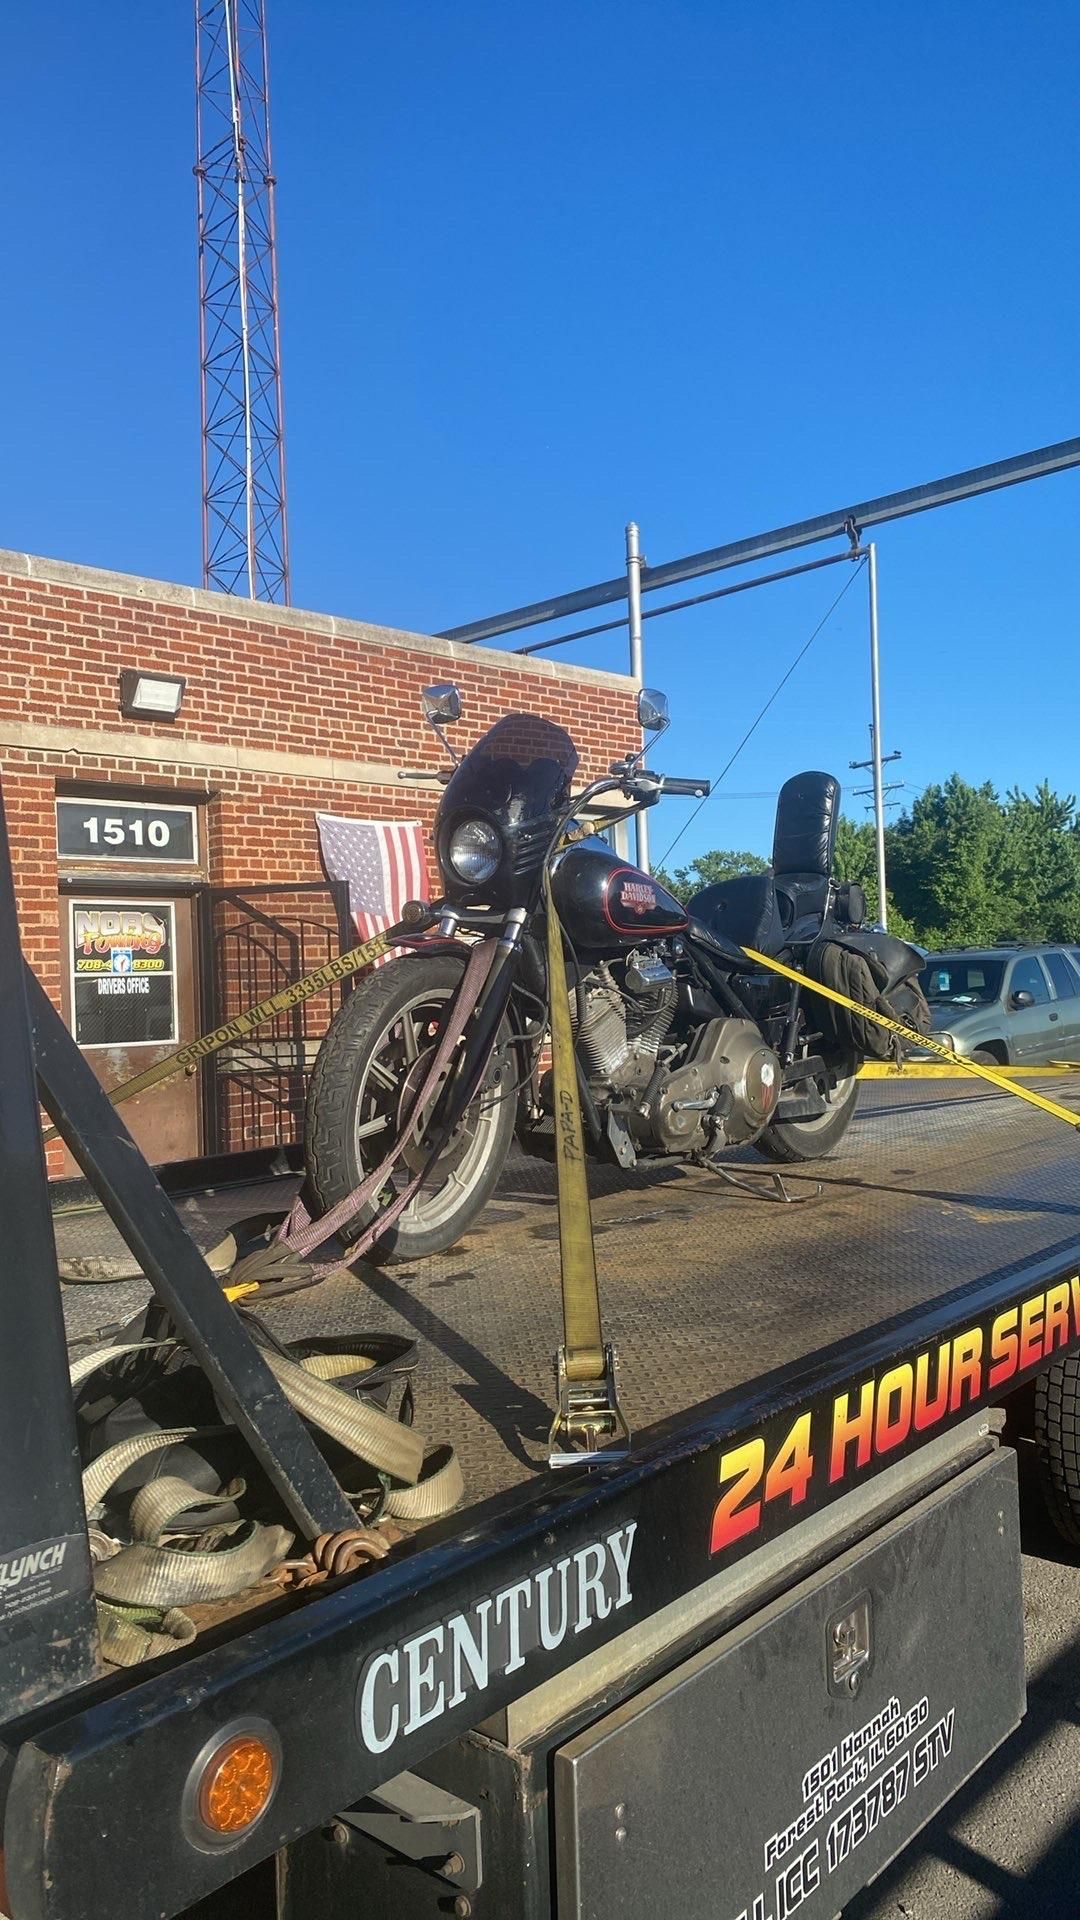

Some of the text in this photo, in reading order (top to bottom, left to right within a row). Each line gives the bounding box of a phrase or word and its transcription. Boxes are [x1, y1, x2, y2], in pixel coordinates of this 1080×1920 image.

[82, 816, 171, 848] 1510
[620, 890, 657, 905] DAVIDSON
[623, 881, 653, 892] HARLEY
[97, 976, 151, 995] DRIVERS OFFICE
[176, 1023, 241, 1065] GRIPON
[244, 1001, 284, 1027] WLL
[902, 1029, 950, 1056] EVEREST
[709, 1411, 814, 1555] 24
[829, 1326, 984, 1485] HOUR
[359, 1521, 638, 1754] CENTURY
[802, 1696, 900, 1802] 1501 Hannah
[764, 1696, 929, 1872] Forest Park, IL 60130
[776, 1707, 955, 1920] ICC 173787 STV
